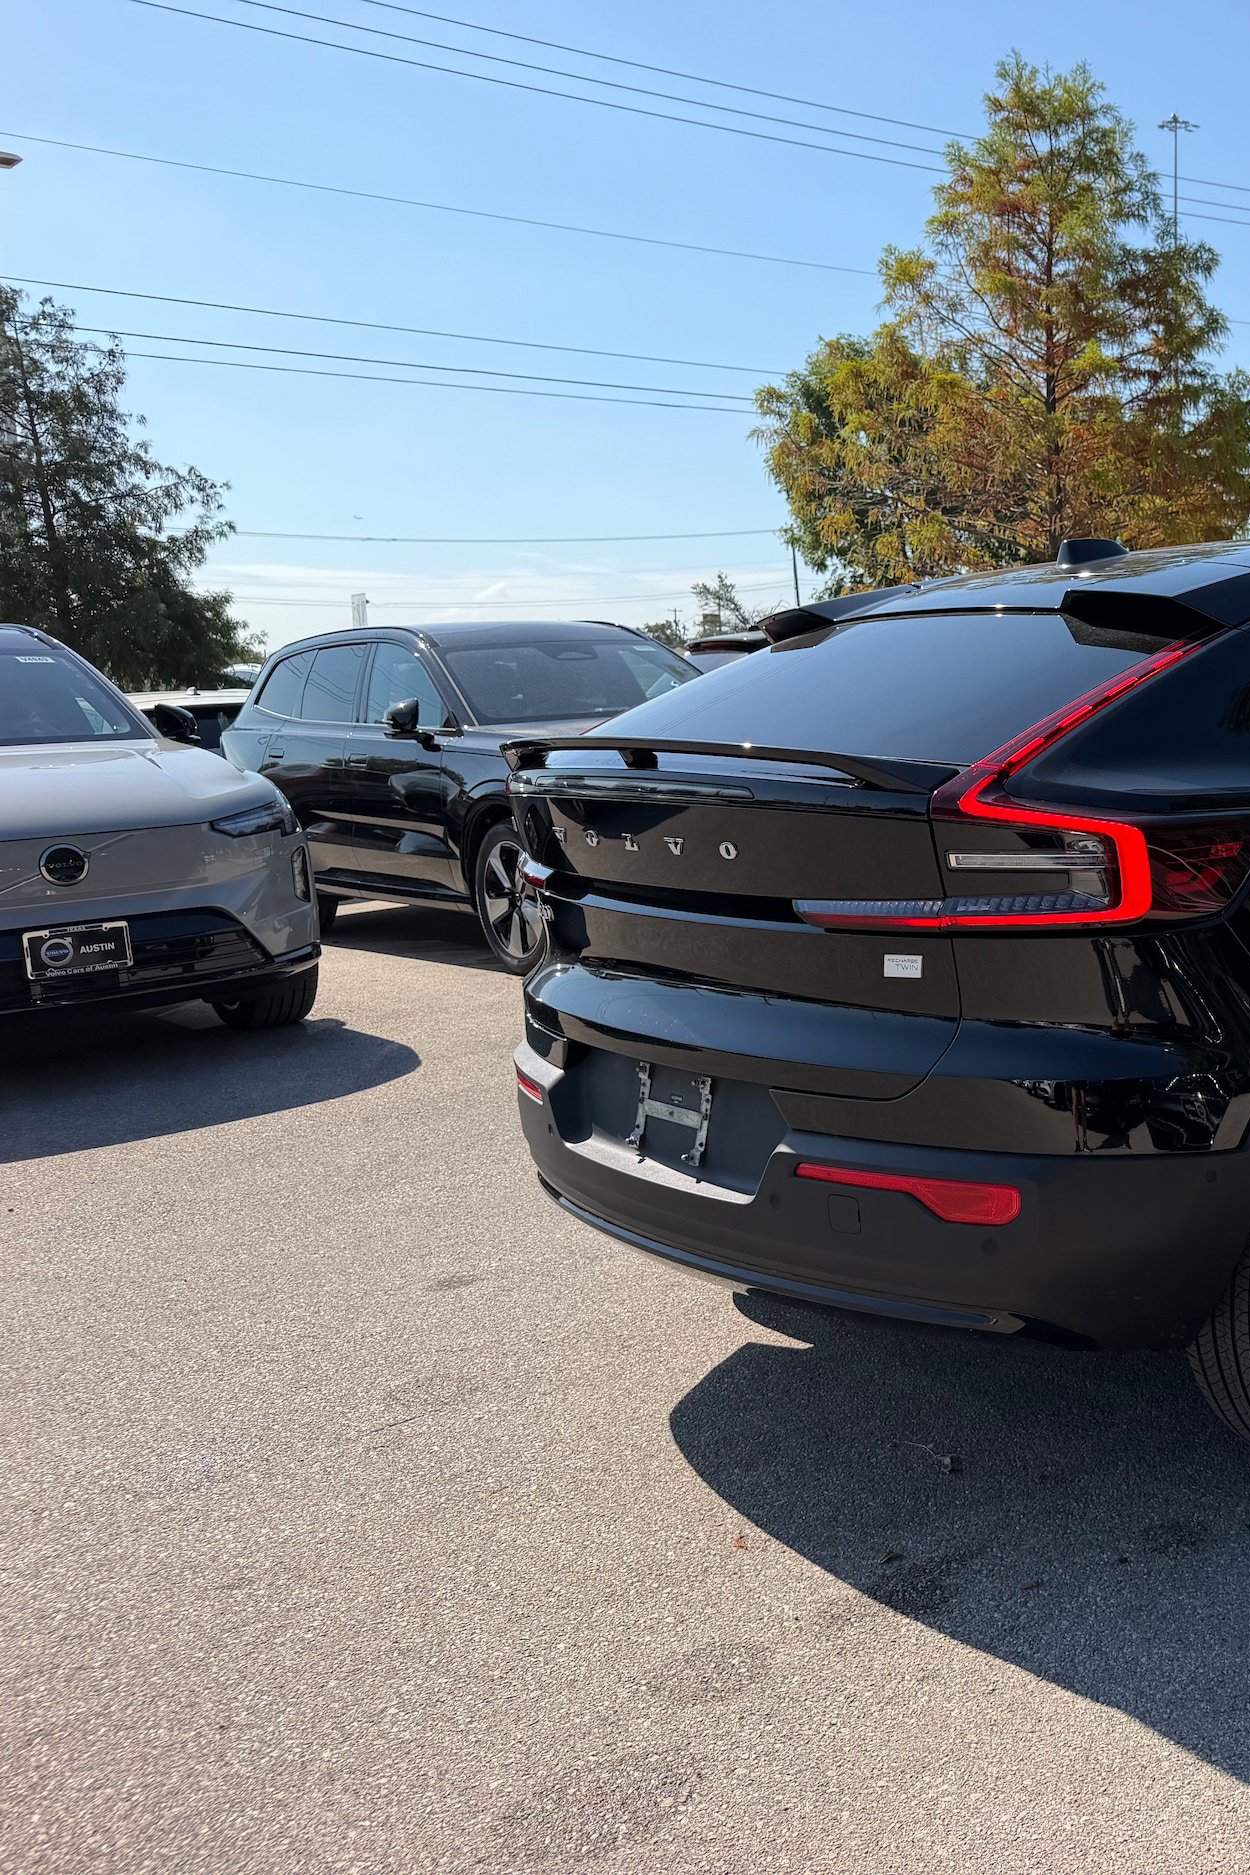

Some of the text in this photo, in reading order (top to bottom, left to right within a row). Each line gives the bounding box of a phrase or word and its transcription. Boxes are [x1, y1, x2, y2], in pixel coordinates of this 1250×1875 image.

[552, 826, 739, 860] VOLVO
[47, 860, 83, 869] VOLVO
[80, 942, 115, 954] AUSTIN
[45, 967, 66, 977] Volvo
[94, 962, 119, 971] Austin
[894, 963, 919, 971] TWIN
